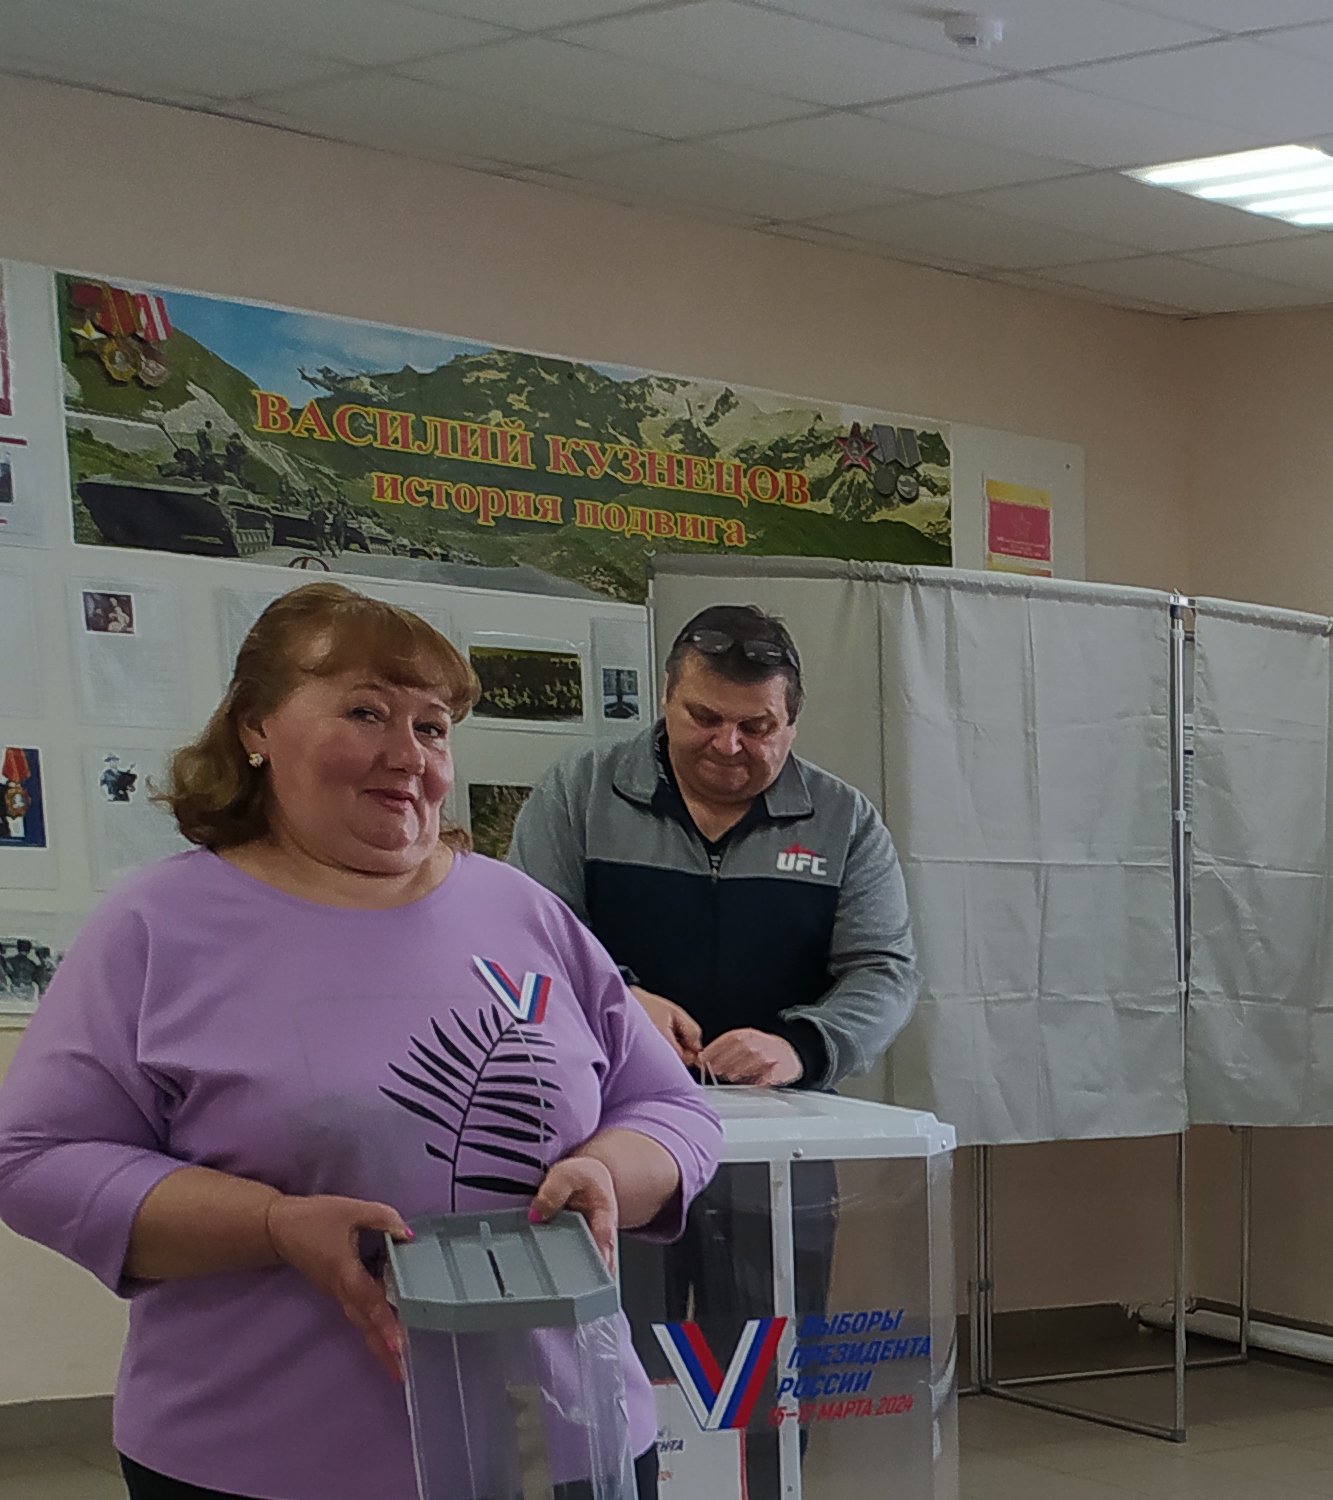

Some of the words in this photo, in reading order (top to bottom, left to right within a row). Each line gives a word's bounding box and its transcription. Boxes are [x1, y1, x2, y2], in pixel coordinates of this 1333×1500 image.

[252, 389, 536, 471] ВАСИЛИЙ
[547, 433, 812, 508] КУЗНЕЦОВ
[373, 471, 562, 527] история
[574, 500, 748, 548] подвига
[776, 852, 828, 877] UFC
[798, 1309, 904, 1338] ВЫБОРЫ
[787, 1336, 932, 1368] ПРЕЗИДЕНТА
[776, 1370, 873, 1399] РОССИИ
[816, 1397, 873, 1421] МАРТА
[875, 1393, 914, 1415] 2024
